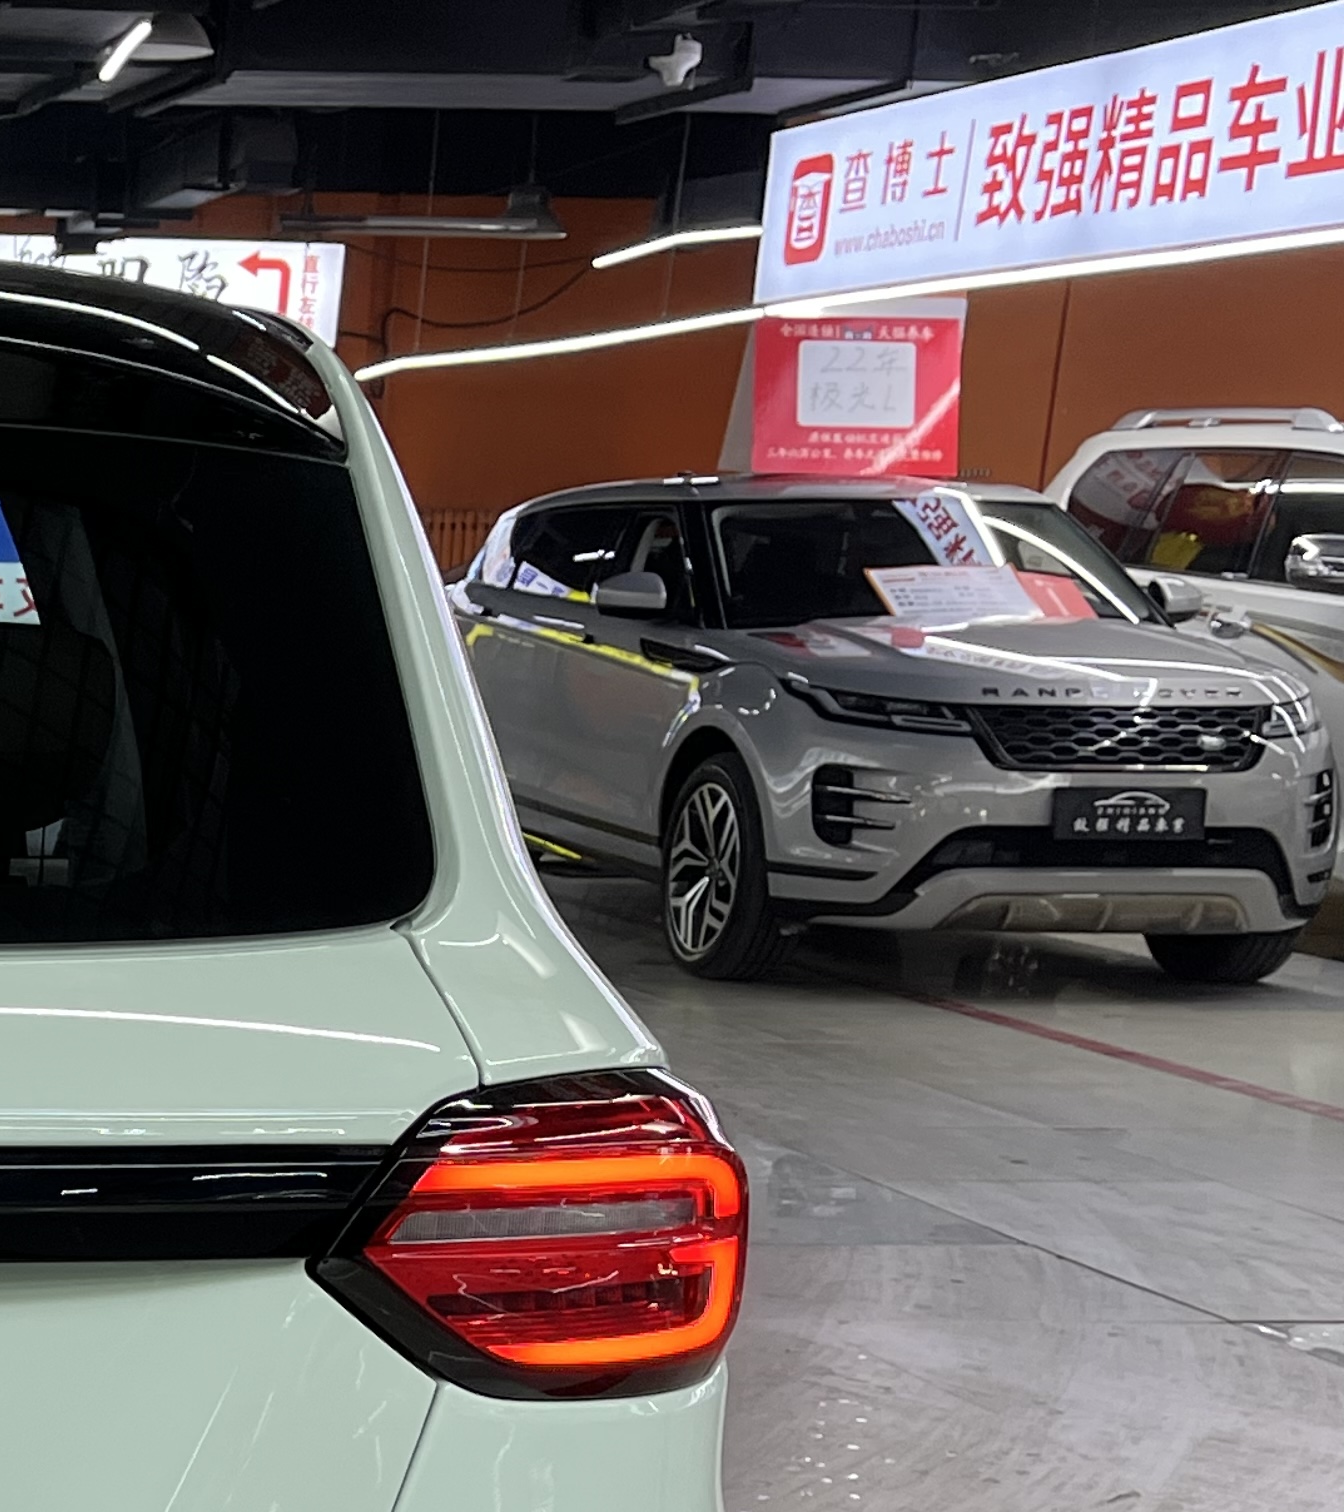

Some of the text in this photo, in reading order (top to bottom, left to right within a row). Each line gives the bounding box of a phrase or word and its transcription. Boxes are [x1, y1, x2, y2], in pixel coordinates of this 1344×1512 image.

[839, 130, 957, 214] 查博士
[975, 48, 1344, 227] 致强精品车业
